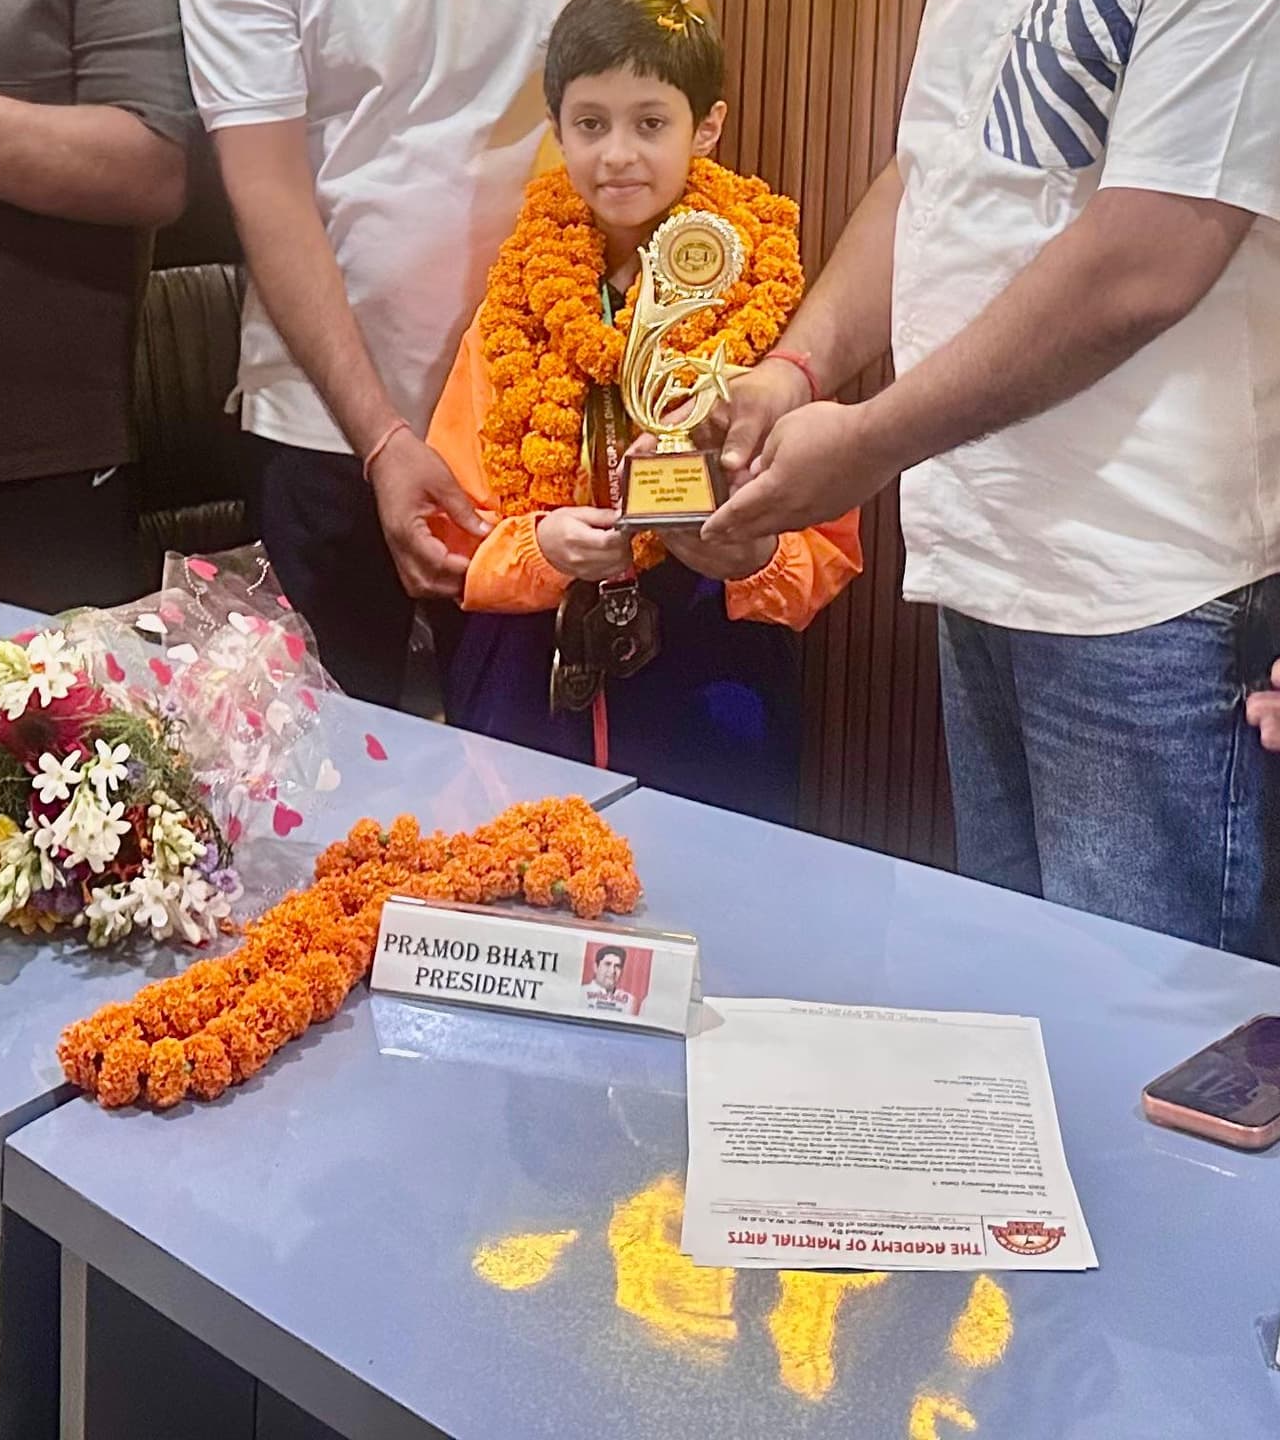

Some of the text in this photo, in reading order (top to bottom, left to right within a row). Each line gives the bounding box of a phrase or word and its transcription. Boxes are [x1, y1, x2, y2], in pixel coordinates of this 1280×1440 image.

[383, 932, 559, 973] PRAMOD BHATI
[415, 966, 543, 1000] PRESIDENT
[728, 1230, 982, 1256] THE ACADEMY OF MARTIAL ARTS
